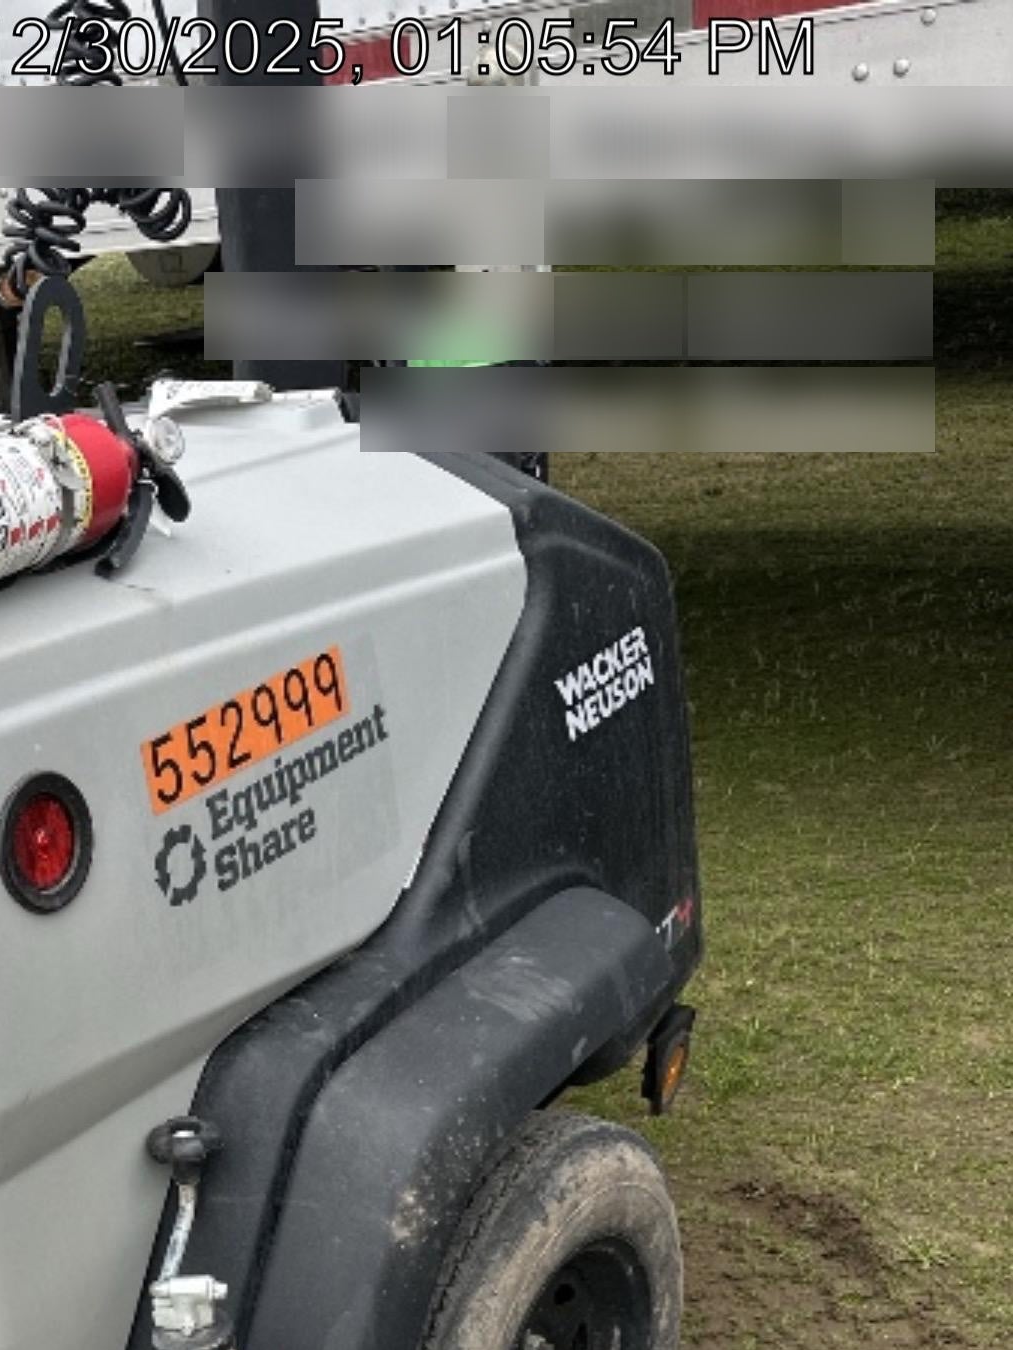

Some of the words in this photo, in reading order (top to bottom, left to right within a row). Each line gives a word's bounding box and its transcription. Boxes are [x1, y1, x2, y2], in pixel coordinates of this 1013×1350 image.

[554, 626, 648, 706] WACKER
[565, 656, 655, 742] NEUSON
[150, 653, 342, 804] 552999
[205, 704, 388, 840] Equipment
[214, 807, 317, 891] Share
